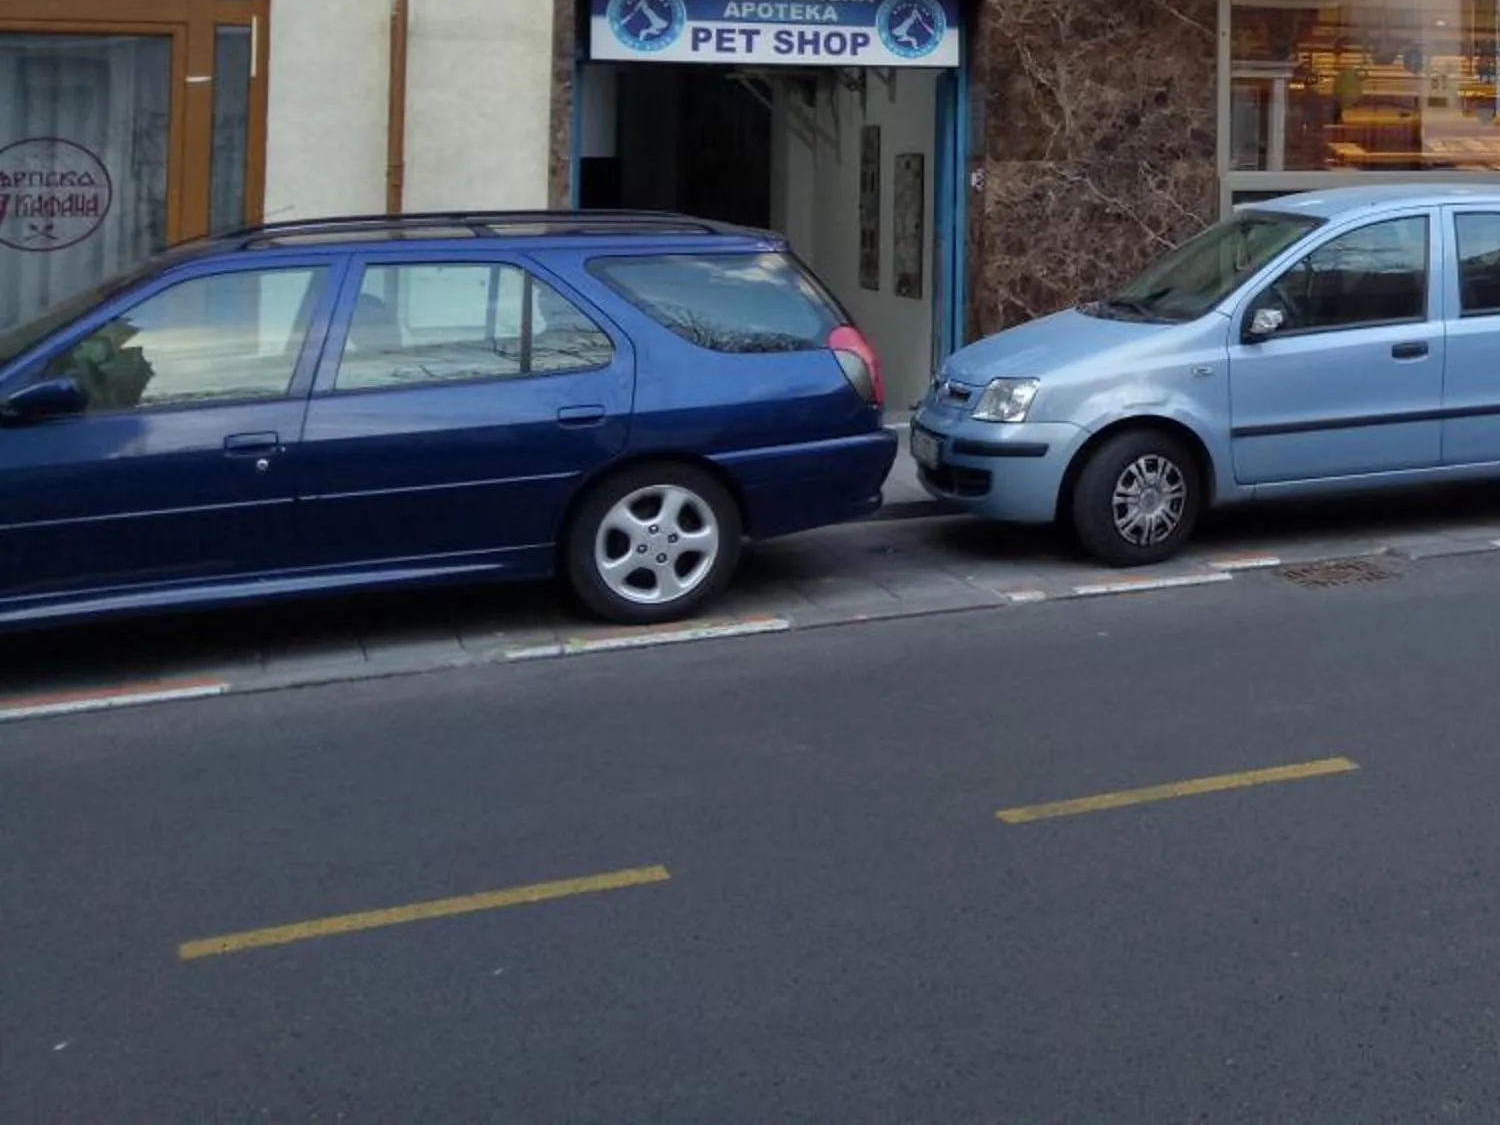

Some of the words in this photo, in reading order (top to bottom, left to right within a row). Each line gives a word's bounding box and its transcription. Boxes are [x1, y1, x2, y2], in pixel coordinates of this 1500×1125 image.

[723, 1, 839, 23] APOTEKA
[691, 27, 760, 53] PET
[773, 30, 871, 57] SHOP
